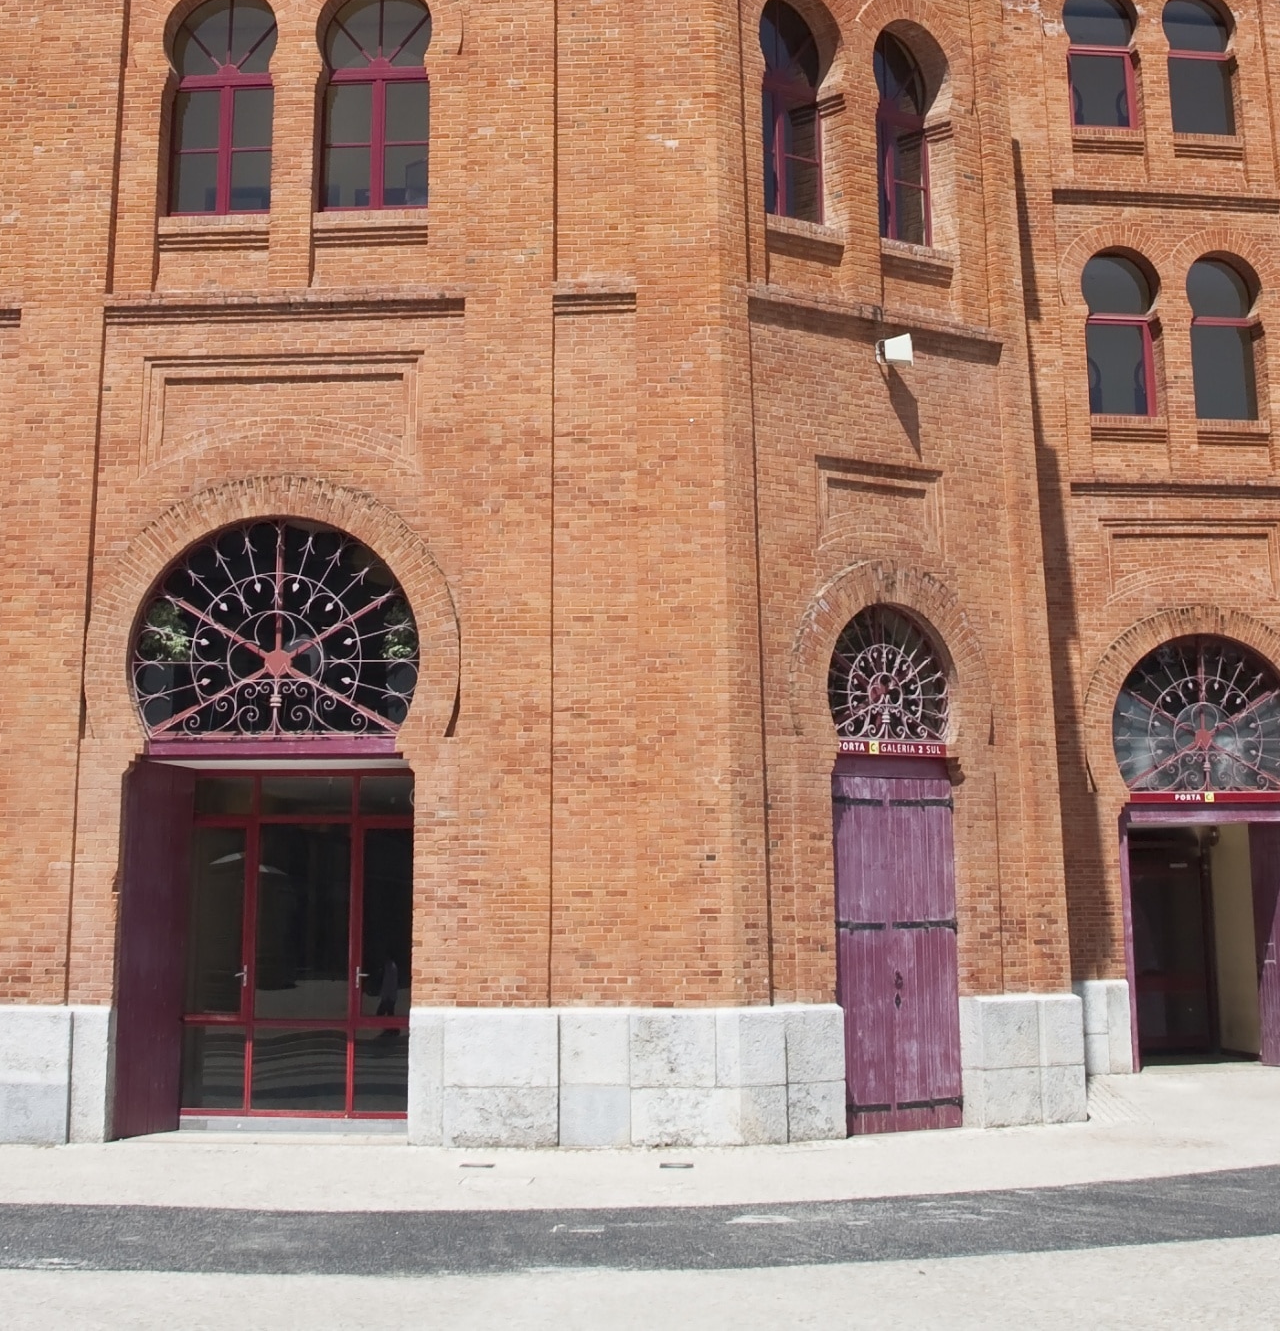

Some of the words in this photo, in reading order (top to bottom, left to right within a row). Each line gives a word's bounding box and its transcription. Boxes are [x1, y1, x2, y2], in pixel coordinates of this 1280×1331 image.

[870, 743, 876, 752] C
[881, 743, 915, 753] GALERIA
[926, 745, 941, 754] SUL
[1174, 793, 1201, 801] PORTA
